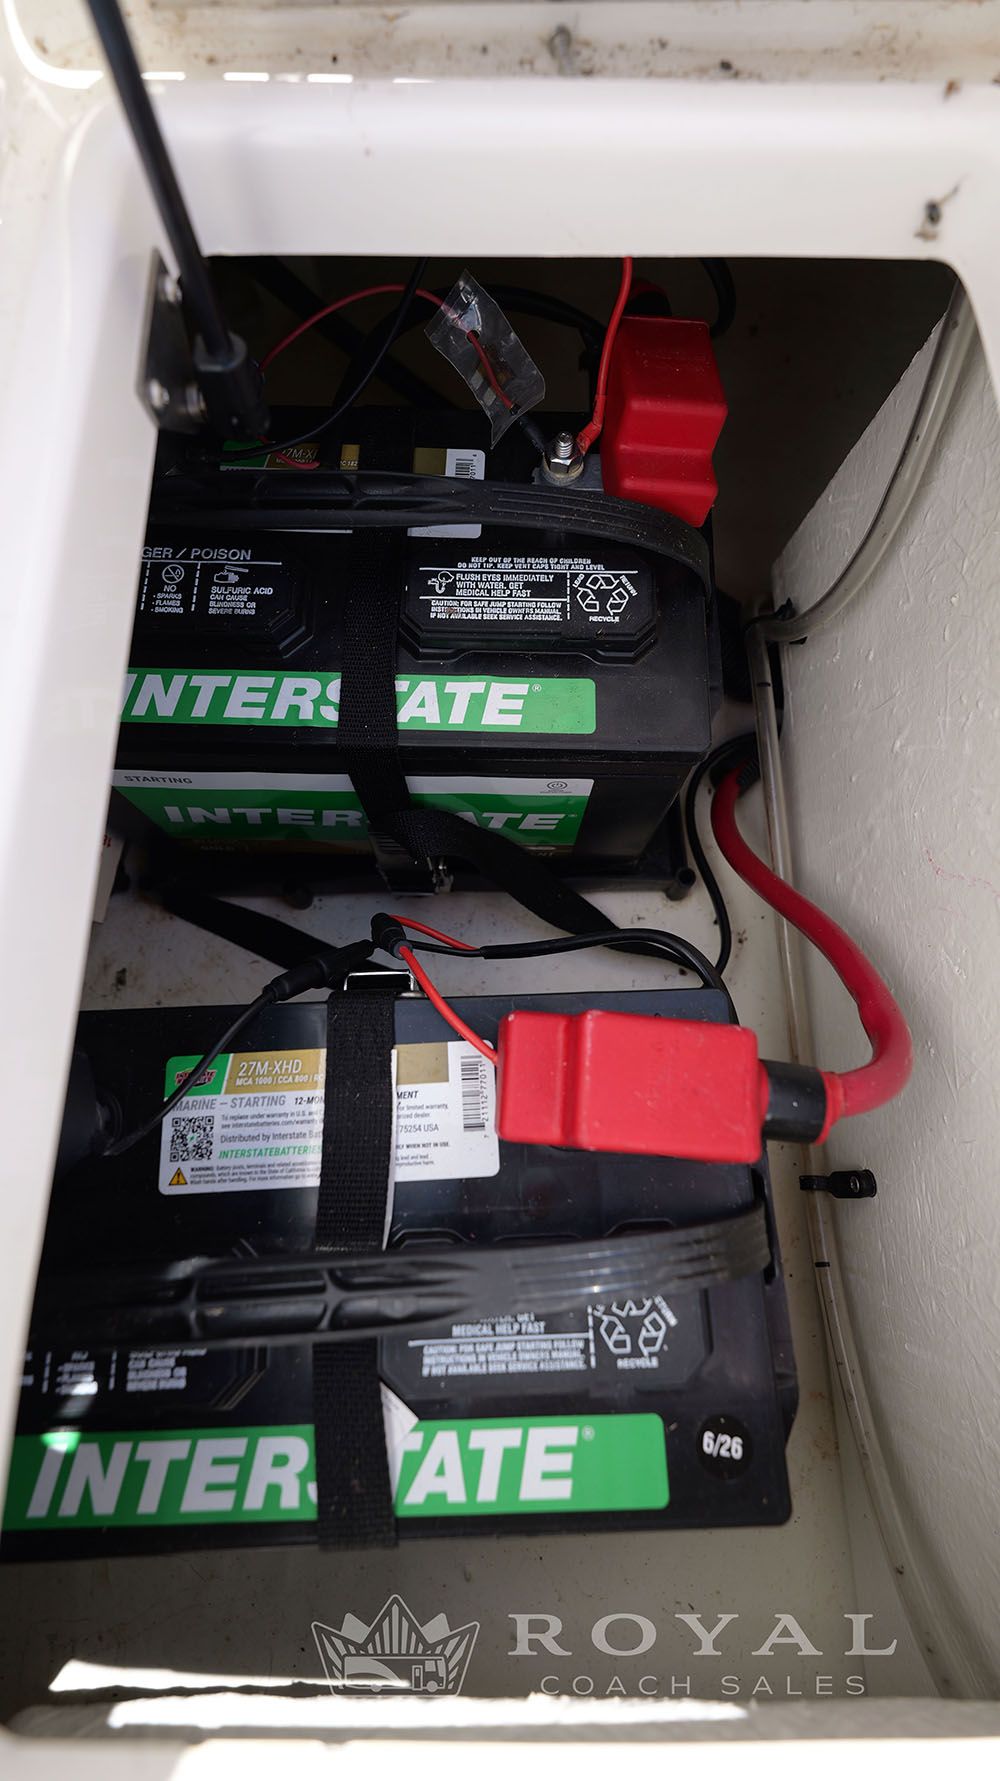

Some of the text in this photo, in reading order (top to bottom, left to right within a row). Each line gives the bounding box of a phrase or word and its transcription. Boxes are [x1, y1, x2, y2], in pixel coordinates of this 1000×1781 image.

[190, 548, 251, 560] POISON
[456, 573, 480, 581] FLUSH
[503, 574, 554, 582] IMMEDIATELY
[210, 586, 273, 595] SULFURIC ACID
[456, 581, 476, 589] WITH
[509, 582, 524, 590] GET
[455, 589, 489, 597] MEDICAL
[491, 589, 510, 597] HELP
[450, 612, 482, 620] AVAILABLE
[589, 615, 620, 623] RECYCLE
[125, 775, 193, 784] STARTING
[238, 1059, 302, 1076] 27M-XHD
[235, 1077, 253, 1087] MCA
[278, 1075, 293, 1085] CCA
[172, 1098, 217, 1111] MARINE
[230, 1095, 286, 1109] STARTING
[399, 1123, 439, 1133] 75254 USA
[220, 1133, 260, 1143] Distributed
[261, 1132, 271, 1143] by
[272, 1131, 307, 1141] Interstate
[452, 1321, 546, 1337] MEDICAL HELP FAST
[702, 1429, 743, 1461] 6/26
